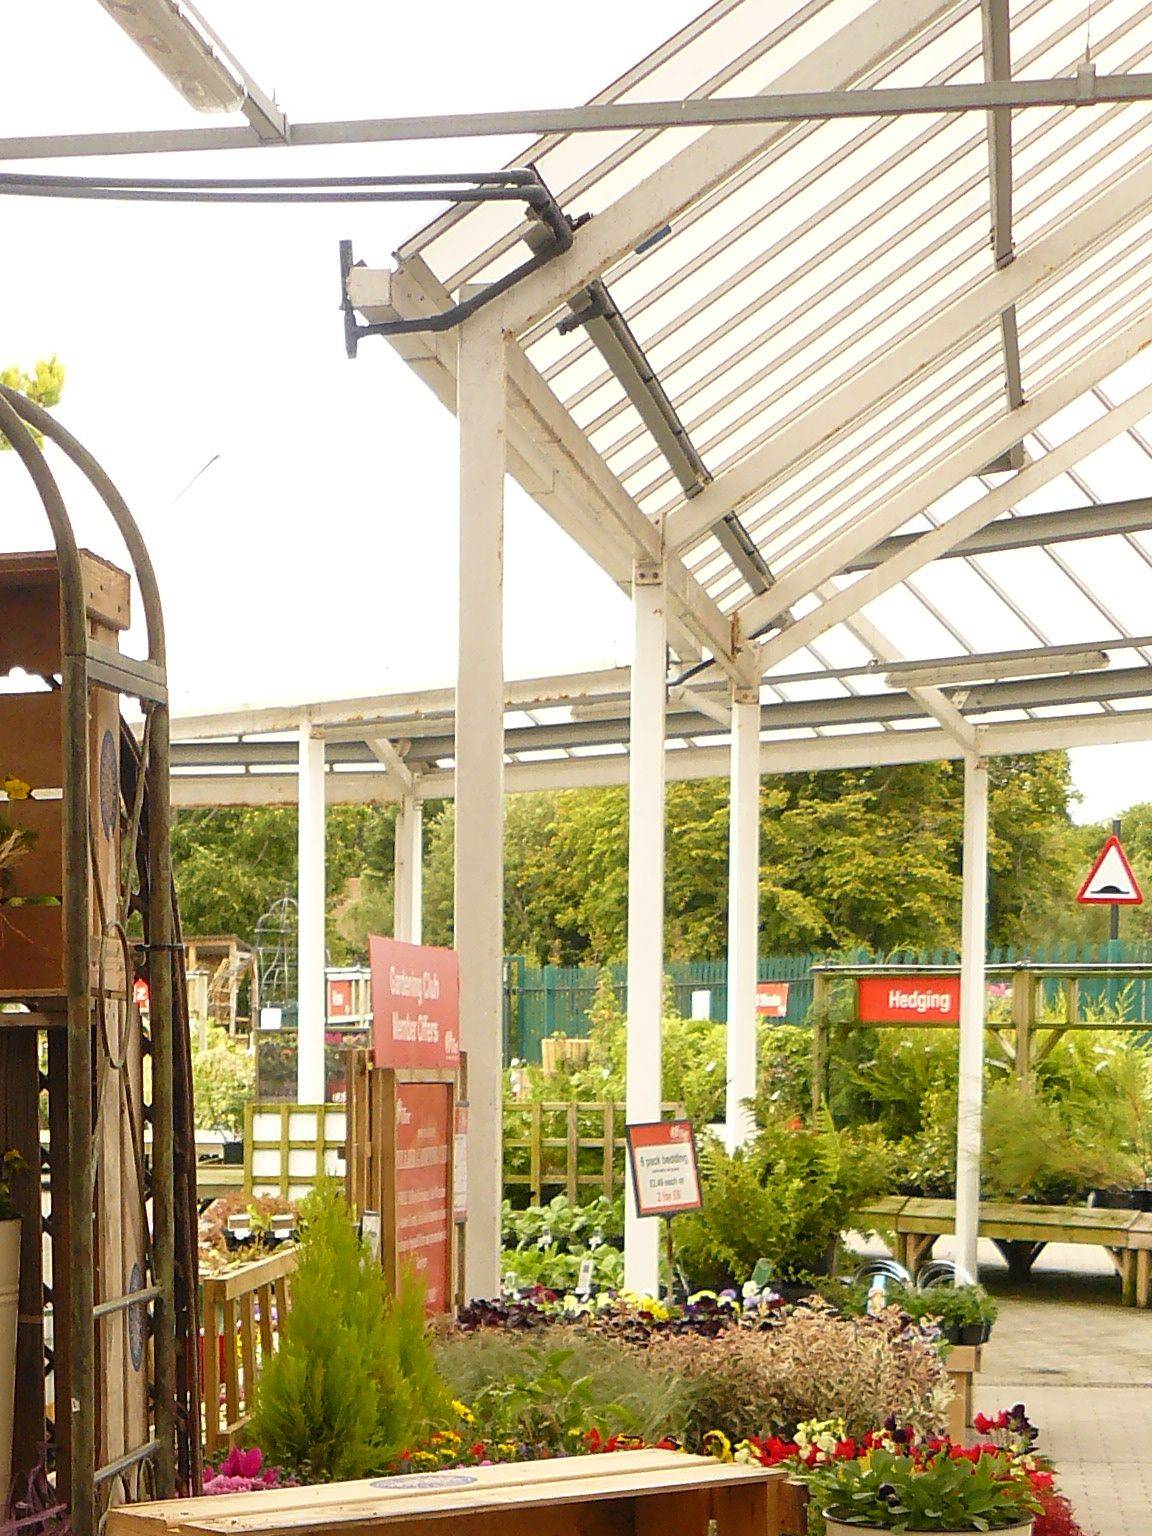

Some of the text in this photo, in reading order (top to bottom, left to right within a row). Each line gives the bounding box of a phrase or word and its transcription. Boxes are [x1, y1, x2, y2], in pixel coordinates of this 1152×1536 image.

[389, 965, 440, 1006] Gardening Club
[888, 989, 951, 1014] Hedging
[391, 1011, 439, 1043] Member Offers
[645, 1156, 660, 1168] pack
[661, 1152, 688, 1165] bedding
